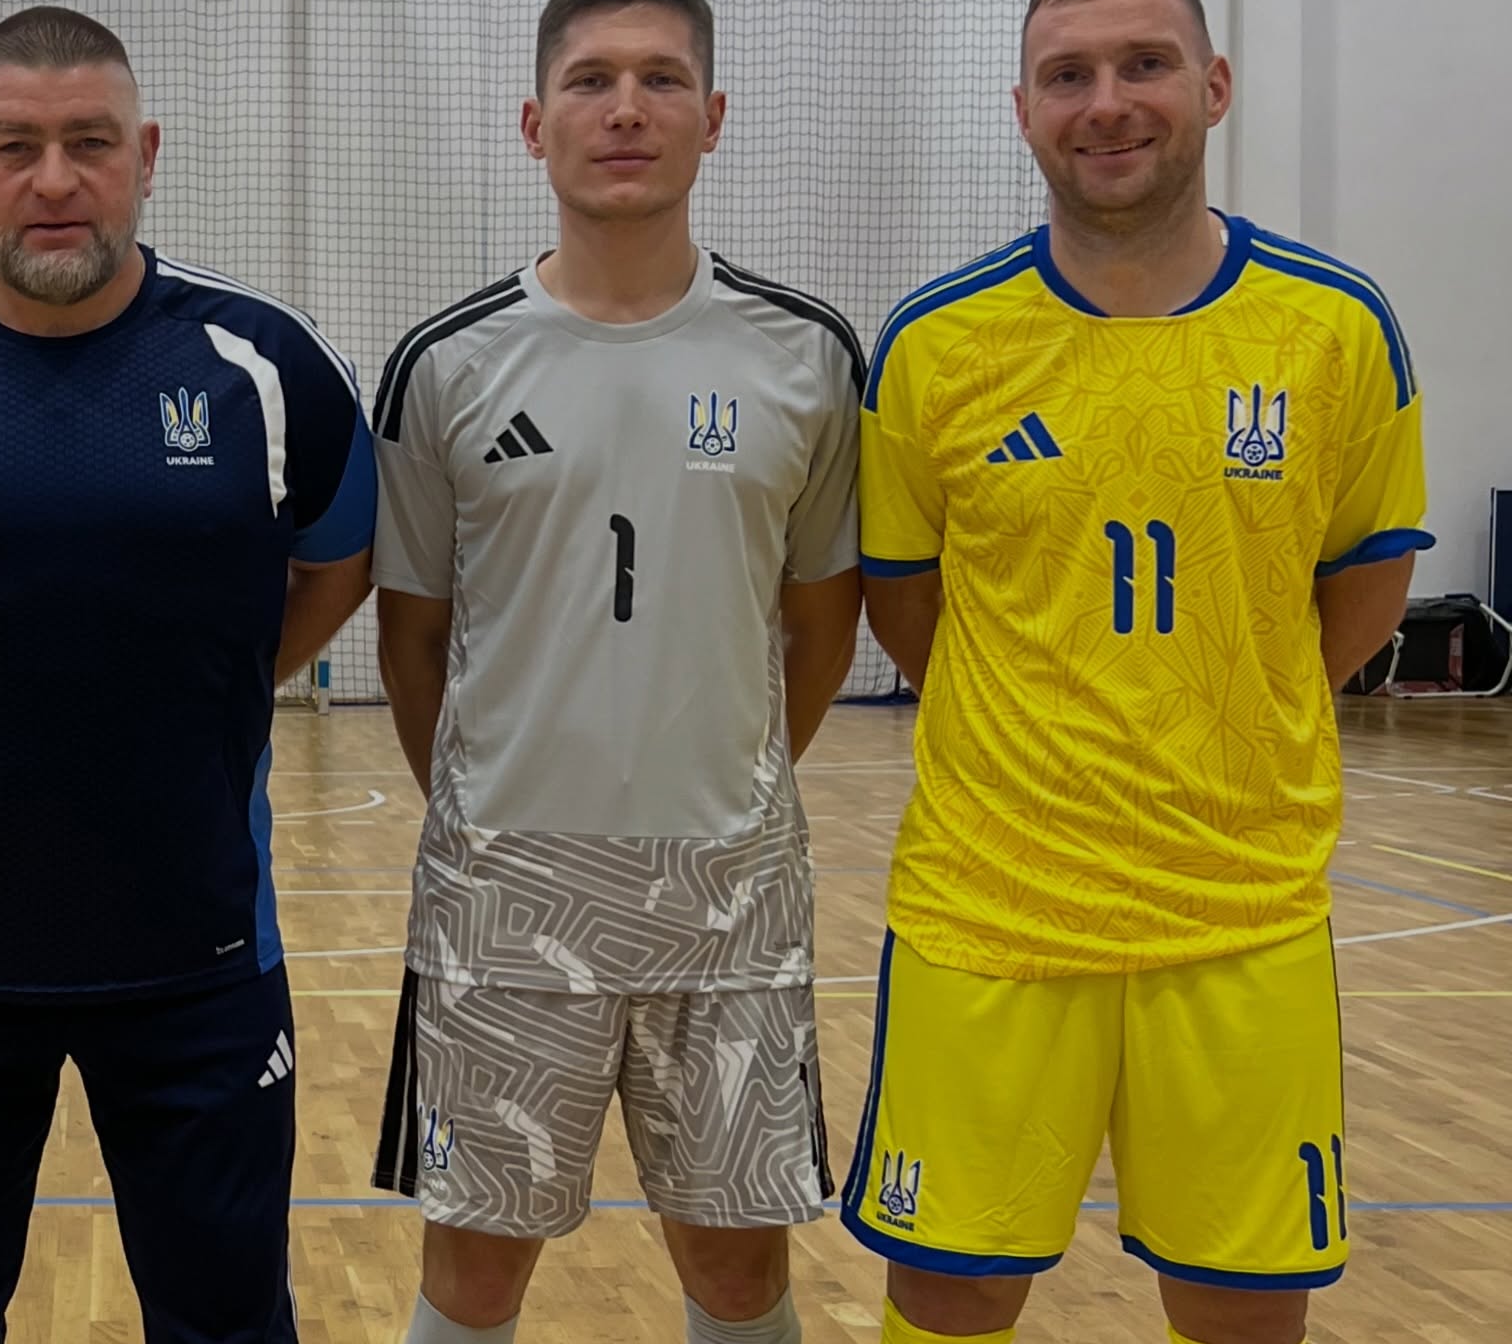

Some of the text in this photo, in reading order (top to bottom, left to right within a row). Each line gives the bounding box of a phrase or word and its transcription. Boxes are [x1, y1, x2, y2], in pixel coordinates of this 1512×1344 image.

[166, 456, 215, 466] UKRAINE
[686, 461, 736, 474] UKRAINE
[1223, 467, 1284, 481] UKRAINE
[609, 513, 636, 623] 1
[1104, 520, 1176, 634] 11
[1298, 1133, 1348, 1251] 11
